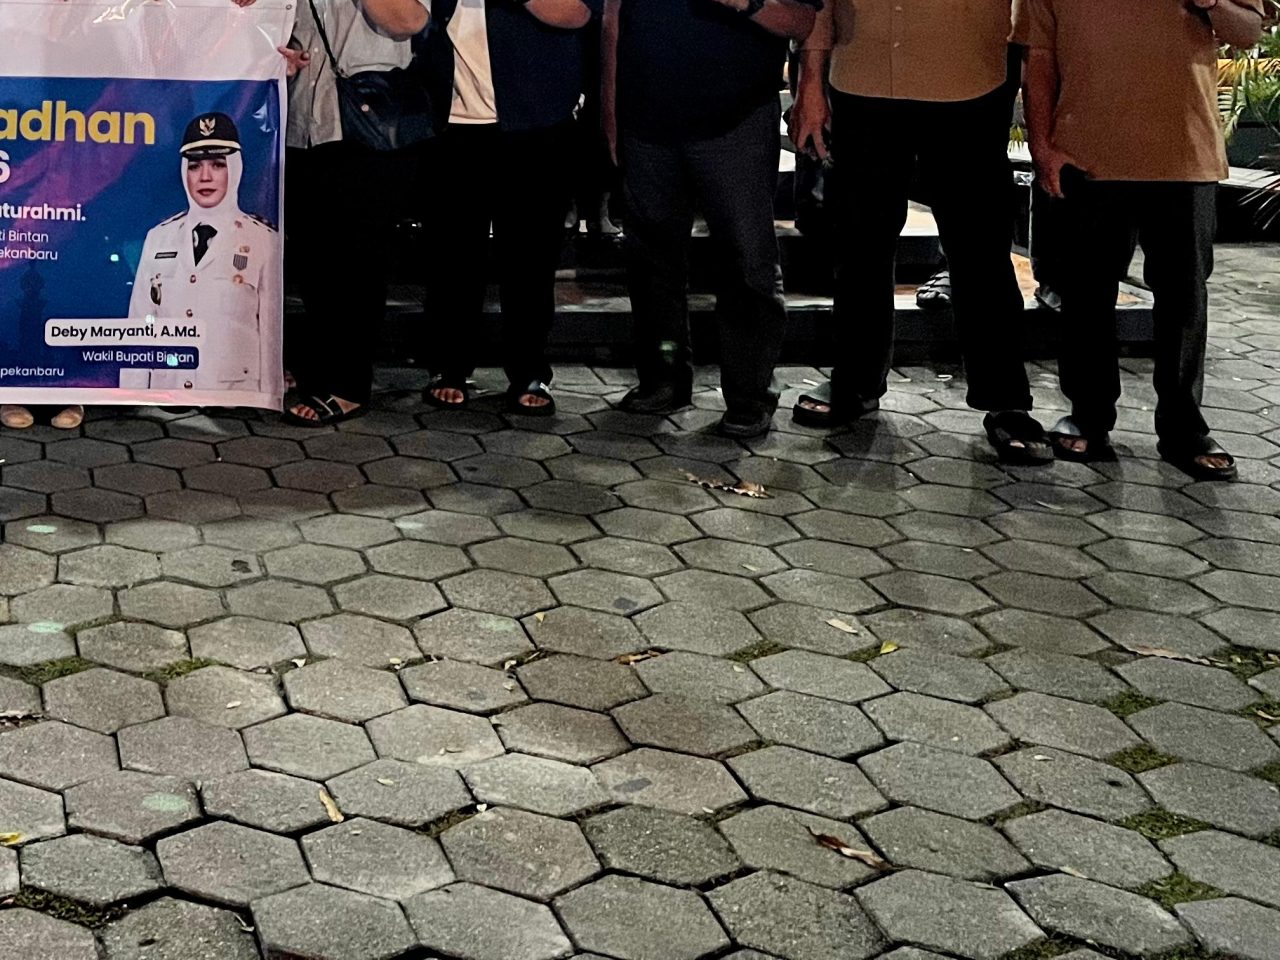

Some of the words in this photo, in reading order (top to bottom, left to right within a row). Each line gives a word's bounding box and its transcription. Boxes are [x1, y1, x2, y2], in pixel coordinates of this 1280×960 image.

[8, 230, 48, 243] Bintan
[51, 326, 87, 340] Deby
[90, 325, 157, 340] Maryanti,
[160, 326, 201, 338] A.Md.
[82, 351, 113, 362] Wakil
[116, 352, 154, 365] Bupati
[156, 352, 194, 363] Bitan
